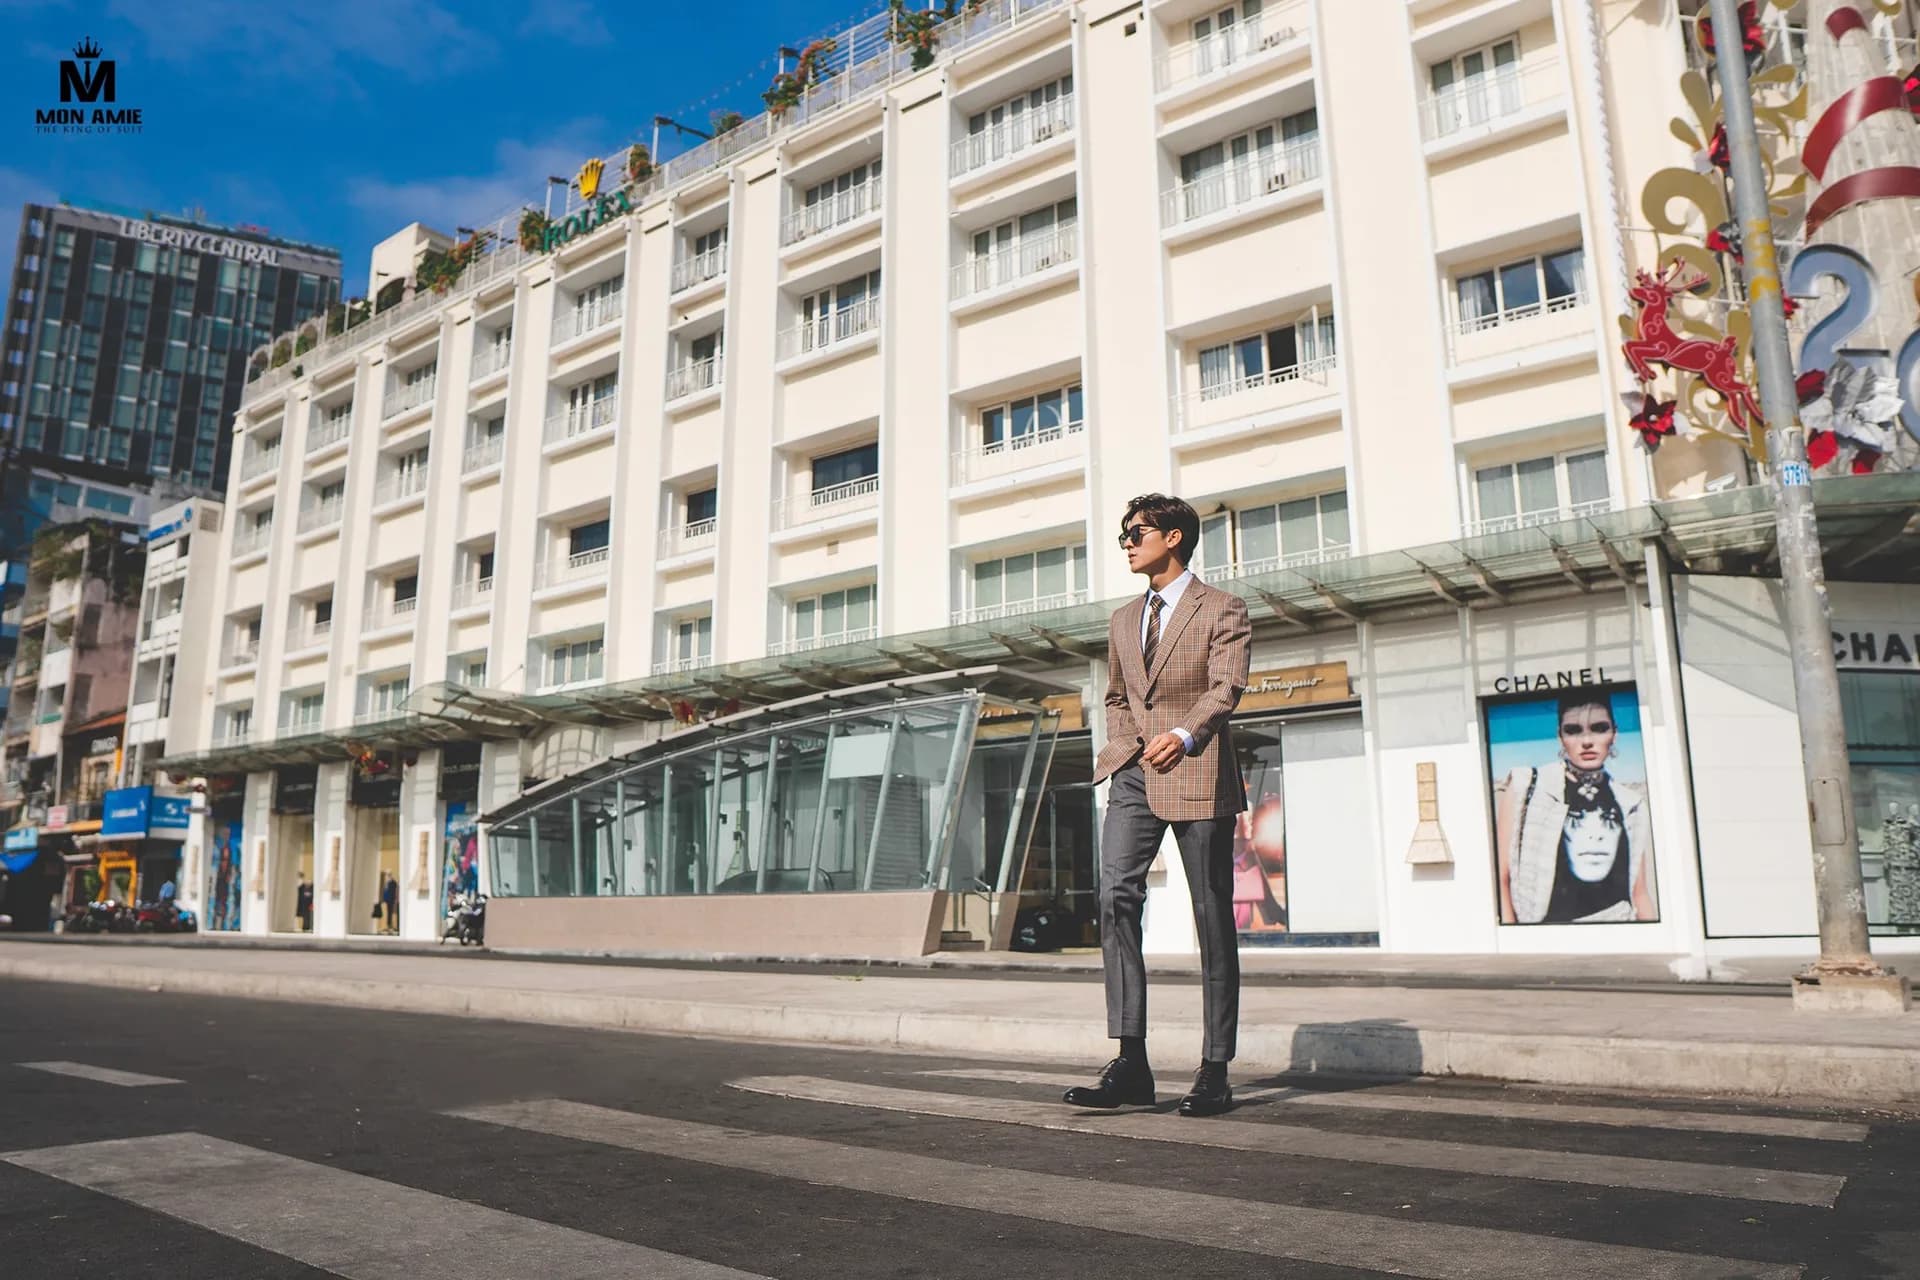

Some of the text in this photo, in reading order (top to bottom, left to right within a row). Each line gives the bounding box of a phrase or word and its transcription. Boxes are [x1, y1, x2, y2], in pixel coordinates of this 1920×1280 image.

[543, 184, 634, 252] ROLEX
[1831, 631, 1920, 663] CHA
[1262, 675, 1324, 699] Ferragamo
[1494, 667, 1613, 693] CHANEL
